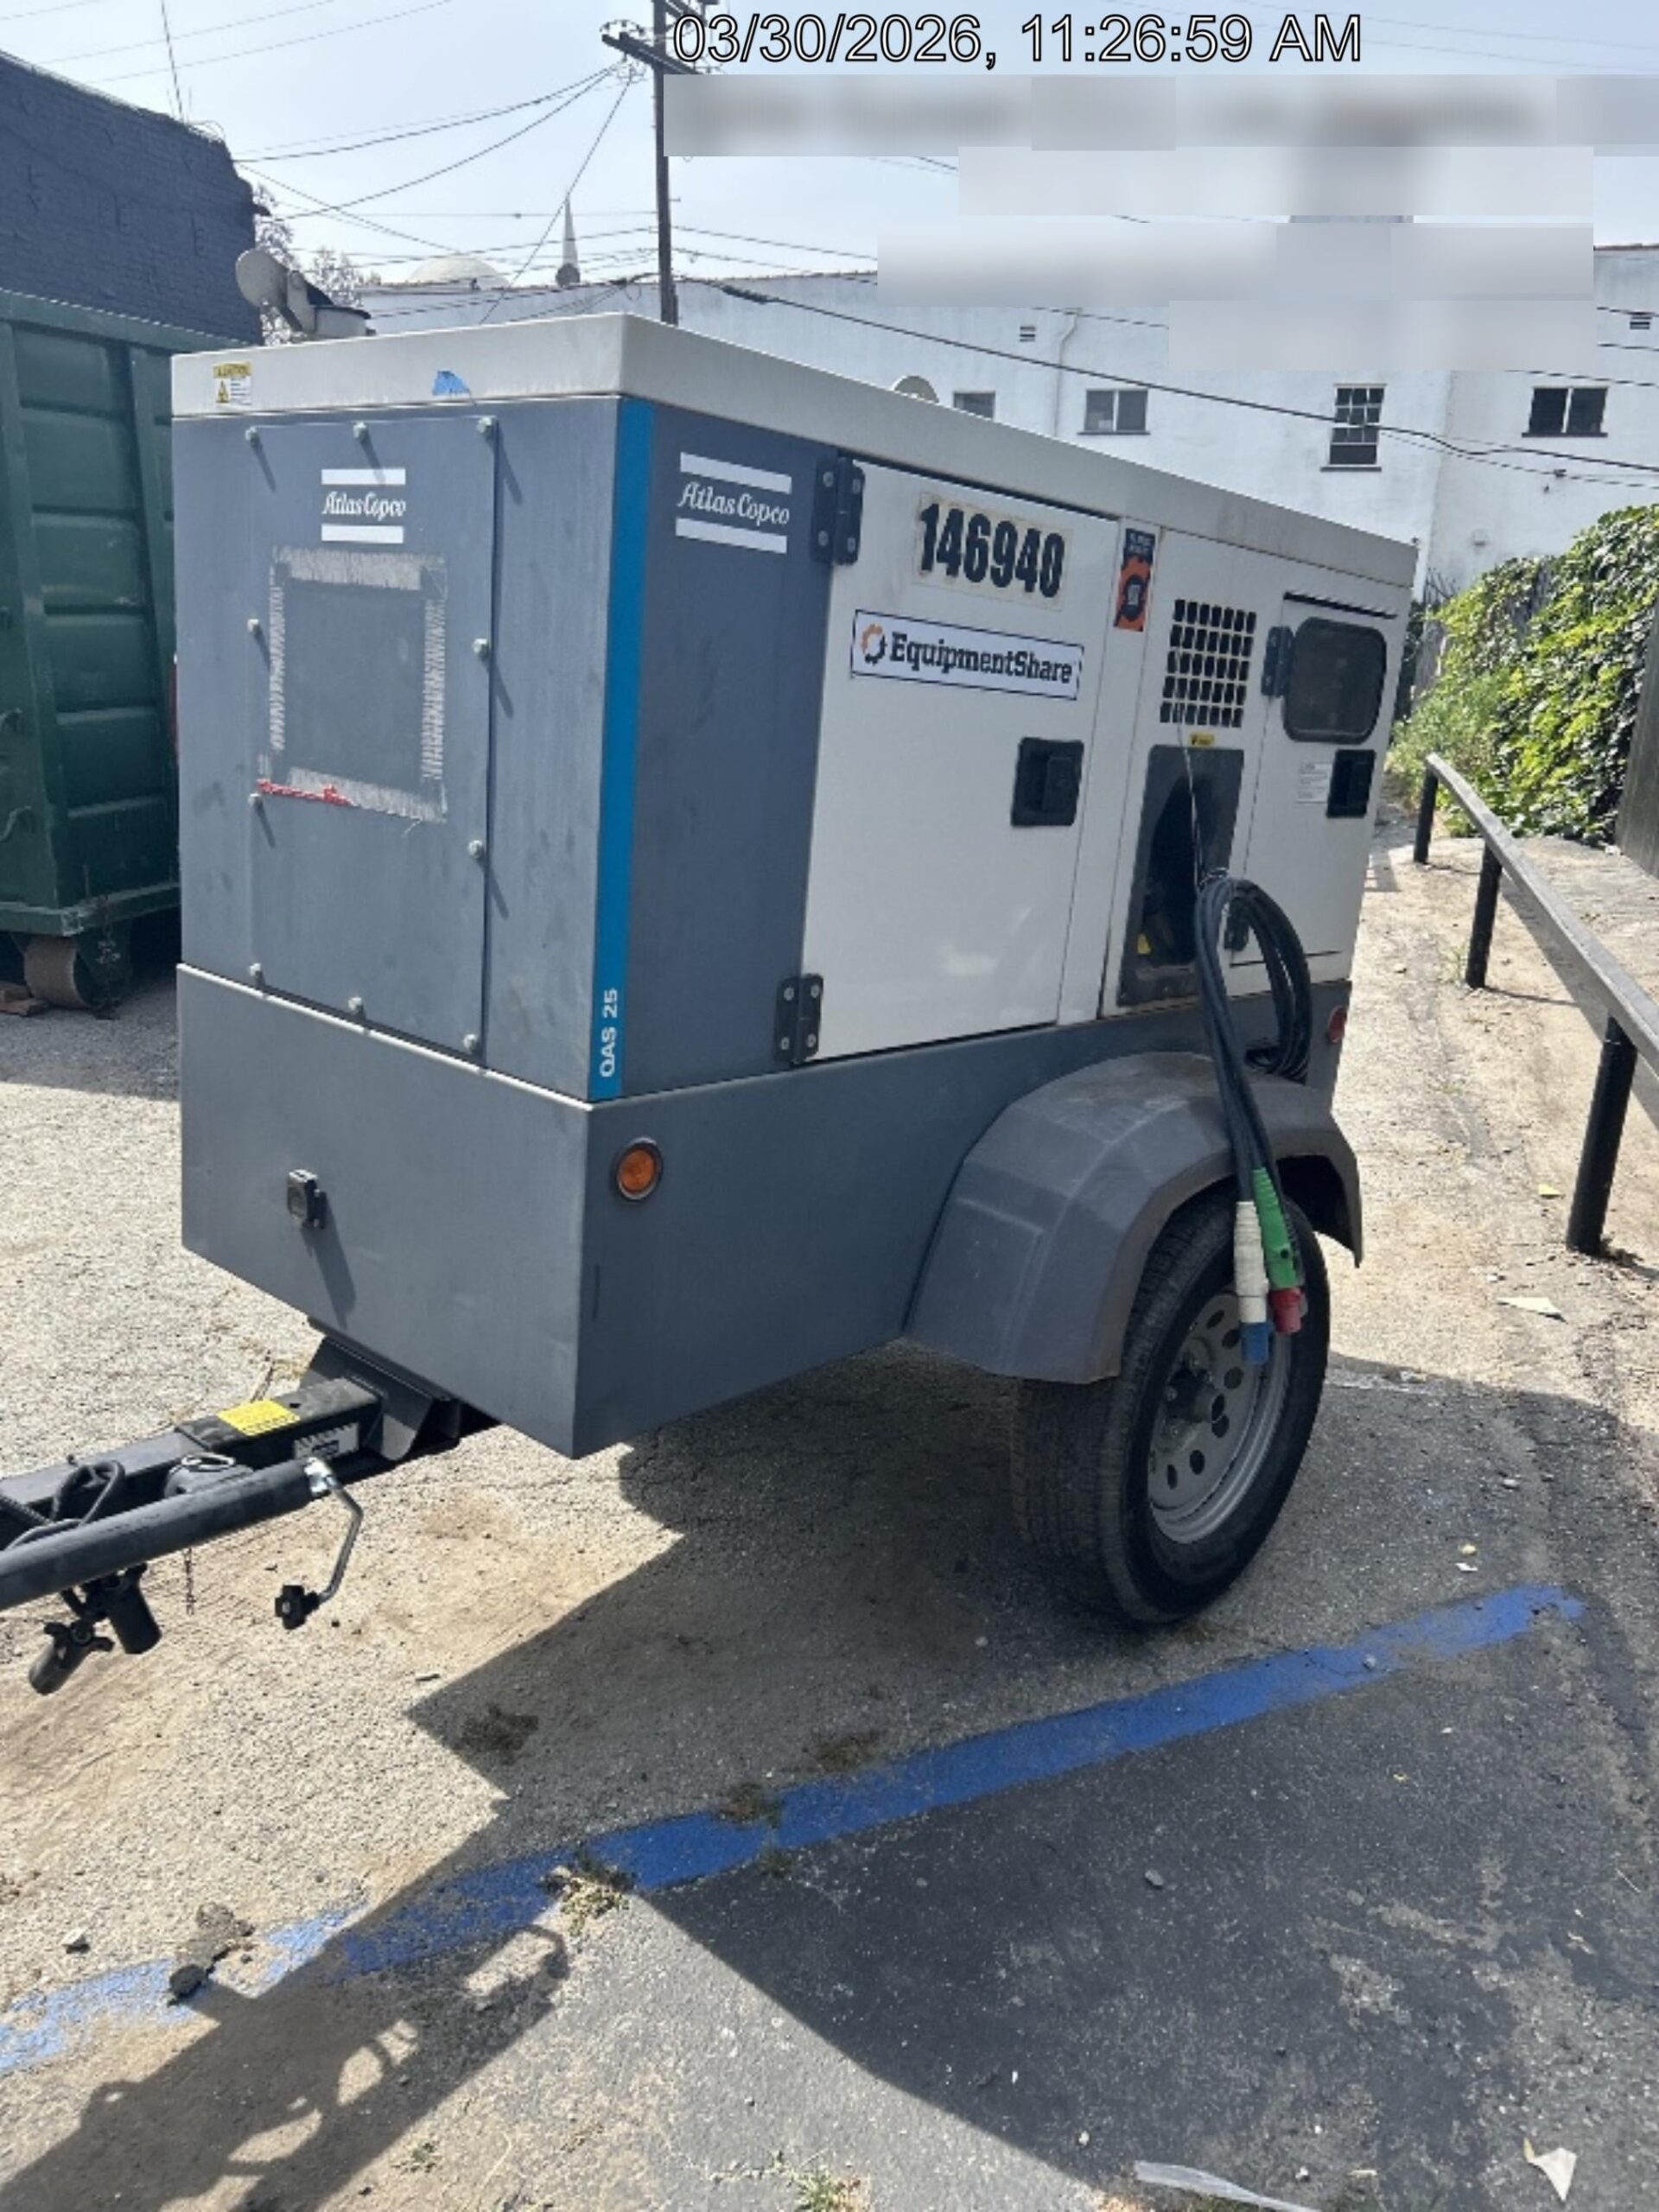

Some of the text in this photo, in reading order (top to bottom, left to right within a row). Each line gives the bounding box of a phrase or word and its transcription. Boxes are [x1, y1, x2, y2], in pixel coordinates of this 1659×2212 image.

[321, 491, 406, 522] Atlas Copco
[677, 480, 791, 527] Atlas Copco
[919, 503, 1066, 599] 146940
[889, 631, 1073, 684] EquipmentShare
[599, 988, 619, 1078] QAS 25
